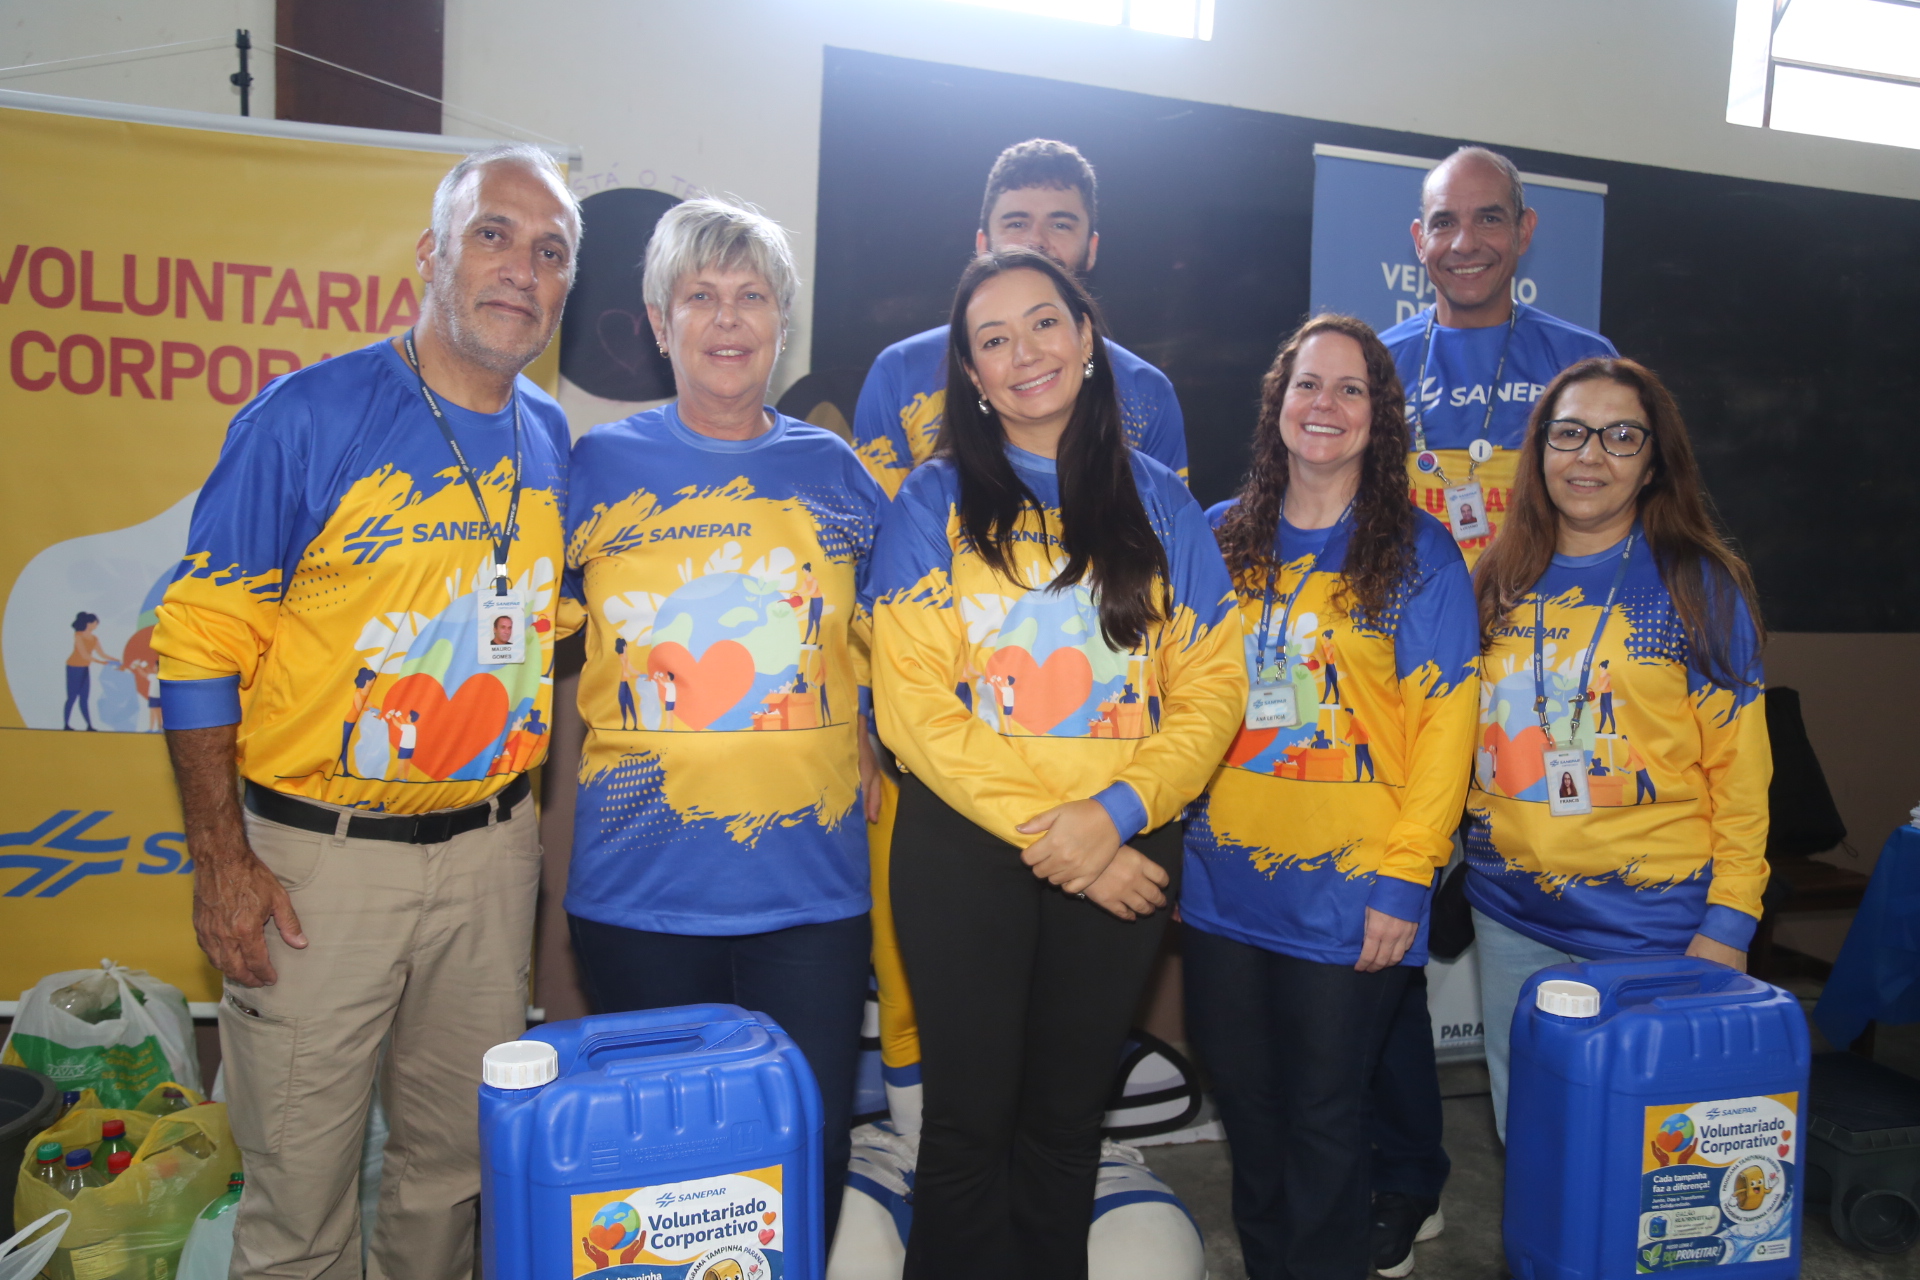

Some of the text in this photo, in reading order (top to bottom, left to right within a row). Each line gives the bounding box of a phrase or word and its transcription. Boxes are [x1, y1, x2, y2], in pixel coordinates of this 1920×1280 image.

[412, 521, 521, 542] SANEPAR
[649, 522, 752, 543] SANEPAR
[1722, 1106, 1757, 1117] SANEPAR
[1700, 1117, 1785, 1139] Voluntariado
[1701, 1134, 1778, 1155] Corporativo
[1653, 1171, 1707, 1183] Cada tampinha
[678, 1187, 727, 1203] SANEPAR
[648, 1197, 767, 1232] Voluntariado
[650, 1219, 758, 1250] Corporativo
[705, 1244, 743, 1260] TAMPINHA
[743, 1246, 764, 1266] PARANÁ
